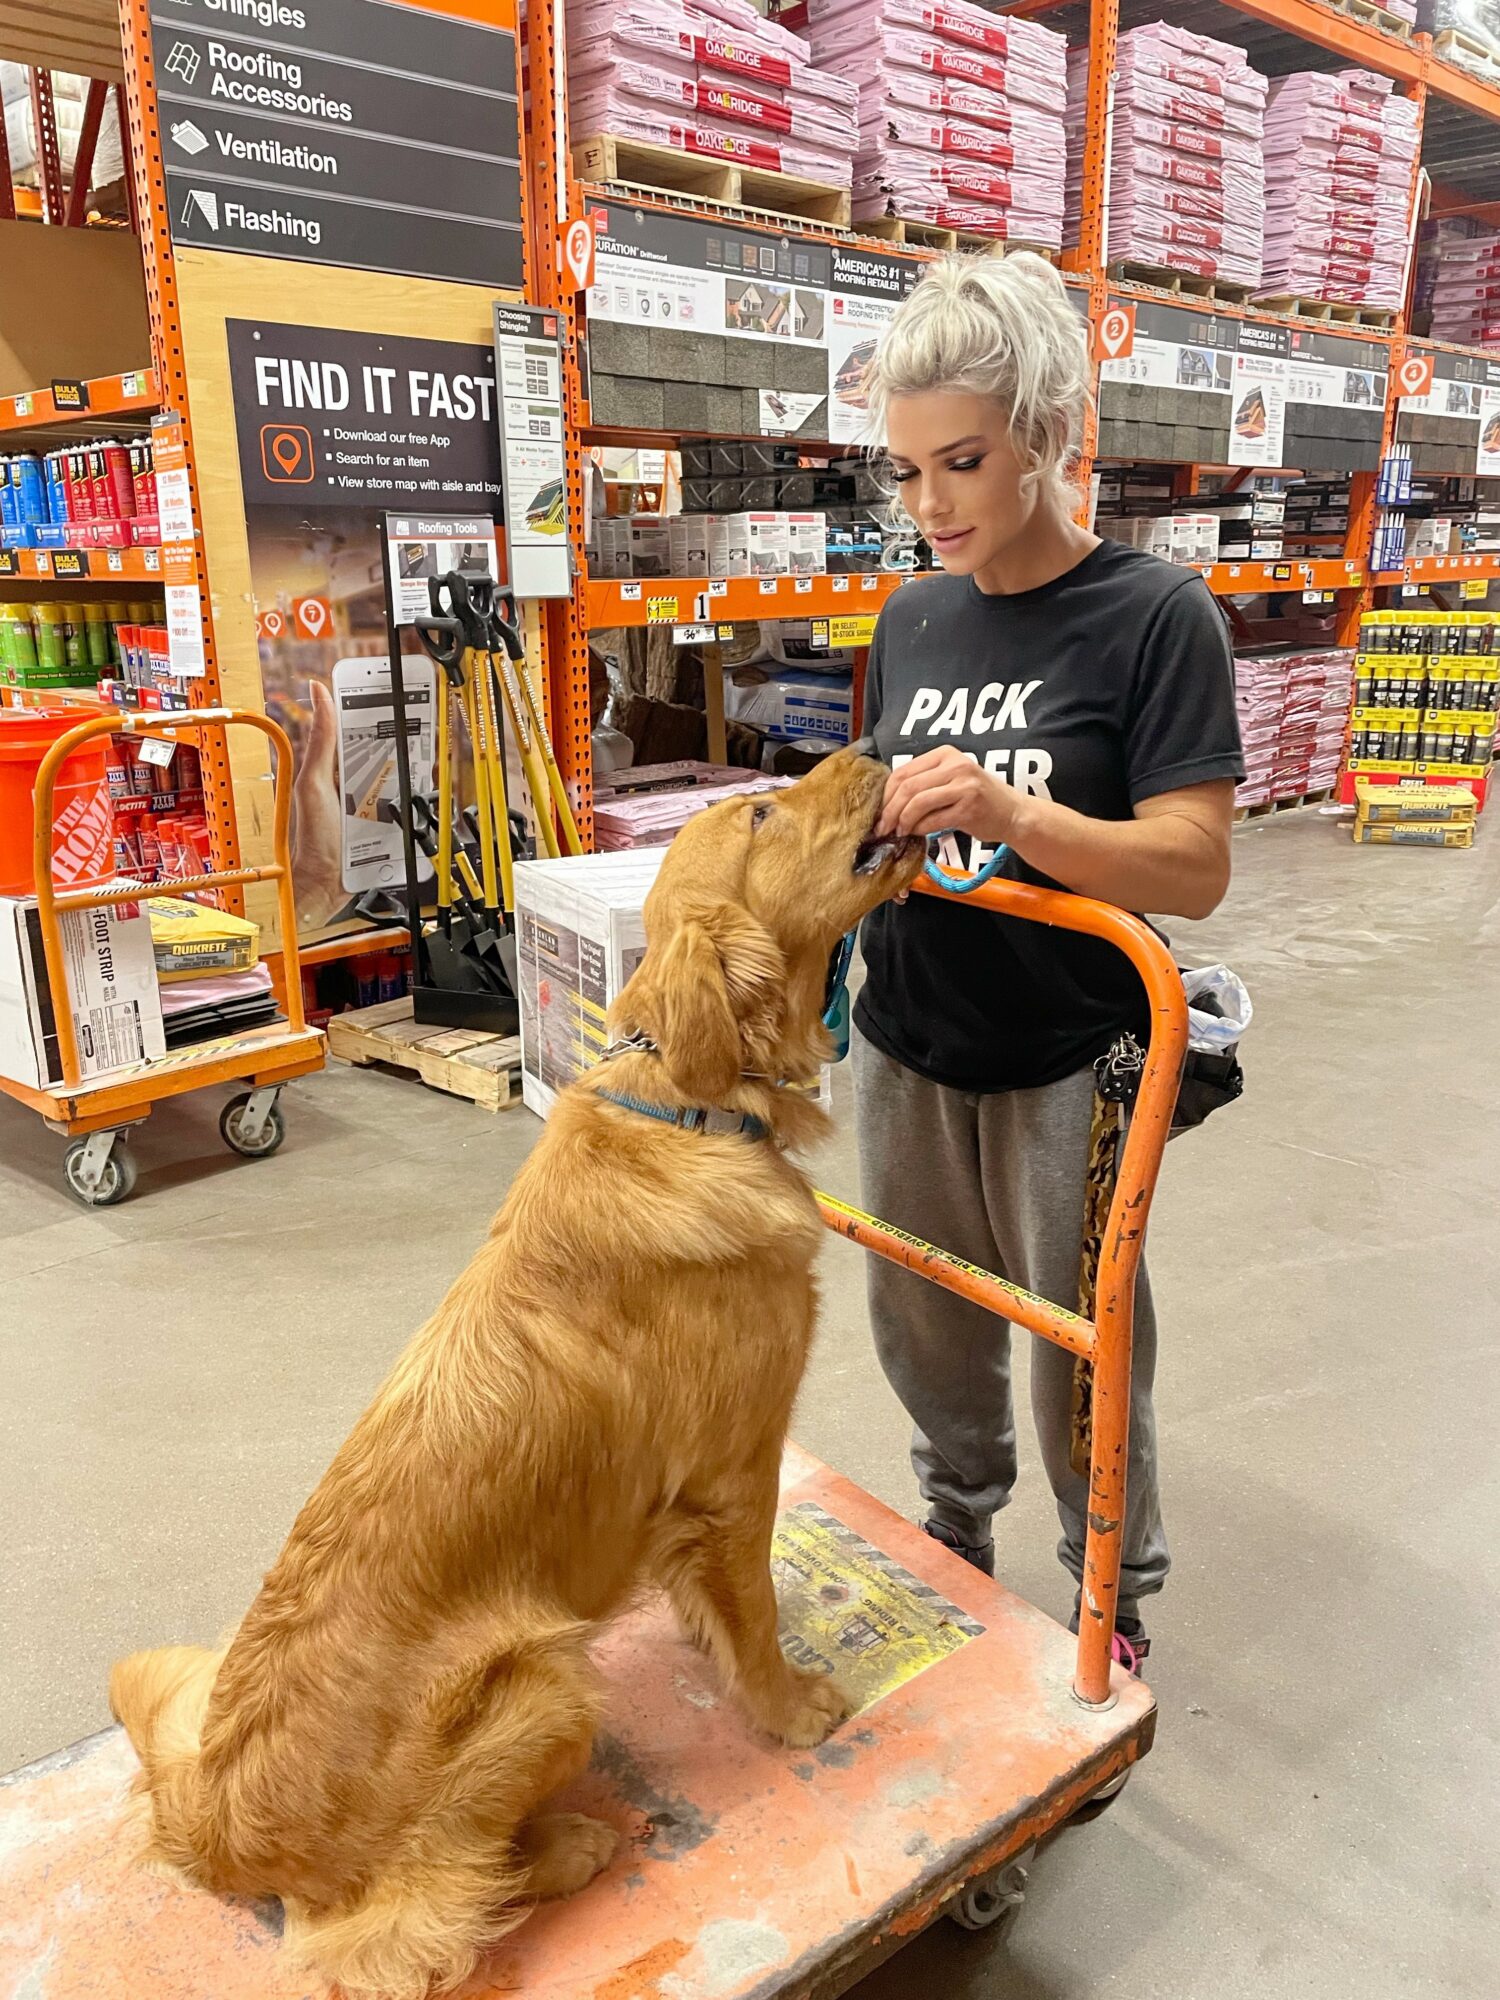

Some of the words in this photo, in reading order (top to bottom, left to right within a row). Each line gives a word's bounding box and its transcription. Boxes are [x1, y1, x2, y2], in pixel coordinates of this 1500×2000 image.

[942, 15, 985, 41] OAKRIDGE
[208, 41, 302, 89] Roofing
[941, 53, 984, 78] OAKRIDGE
[211, 72, 353, 121] Accessories
[707, 90, 763, 117] OARIDGE
[1176, 132, 1206, 150] OAKRIDGE
[214, 130, 338, 175] Ventilation
[224, 202, 321, 244] Flashing
[575, 240, 583, 259] 2
[833, 257, 888, 278] AMERICA'S
[888, 266, 900, 280] #1
[833, 272, 867, 286] ROOFING
[866, 276, 900, 291] RETAILER
[499, 310, 531, 324] Choosing
[499, 320, 529, 333] Shingles
[1110, 323, 1119, 336] 2
[55, 385, 78, 394] BULK
[254, 356, 350, 411] FIND
[362, 366, 396, 414] IT
[408, 370, 495, 421] FAST
[333, 428, 387, 443] Download
[389, 432, 407, 444] our
[408, 432, 428, 445] free
[429, 434, 451, 448] App
[336, 452, 374, 465] Search
[375, 453, 391, 466] for
[392, 456, 407, 467] an
[408, 456, 430, 468] item
[338, 475, 363, 488] View
[366, 477, 393, 490] store
[395, 480, 417, 492] map
[419, 478, 440, 491] with
[441, 479, 464, 492] aisle
[465, 481, 483, 493] and
[484, 481, 501, 496] bay
[418, 521, 453, 536] Roofing
[453, 522, 478, 534] Tools
[55, 554, 78, 562] BULK
[1305, 572, 1312, 587] 4
[1404, 567, 1410, 582] 5
[698, 594, 706, 619] 1
[832, 630, 856, 638] IN-STOCK
[840, 622, 858, 630] SELECT
[500, 660, 516, 701] SHINGLE
[512, 702, 529, 745] STRIPPER
[899, 680, 1045, 735] PACK
[523, 668, 539, 708] SHINGLE
[535, 710, 553, 757] STRIPPER
[152, 794, 175, 803] TITE
[366, 775, 386, 807] Ceiling
[153, 802, 176, 810] FOAM
[1402, 801, 1450, 810] QUIKRETE
[52, 795, 89, 837] THE
[1394, 824, 1443, 834] QUIKRETE
[172, 942, 228, 956] QUIKRETE
[97, 946, 115, 982] STRIP
[109, 985, 118, 1000] WITH
[871, 1219, 926, 1249] OVERLOAD
[926, 1245, 944, 1257] OR
[861, 1598, 898, 1628] RIDING
[897, 1625, 916, 1639] NO
